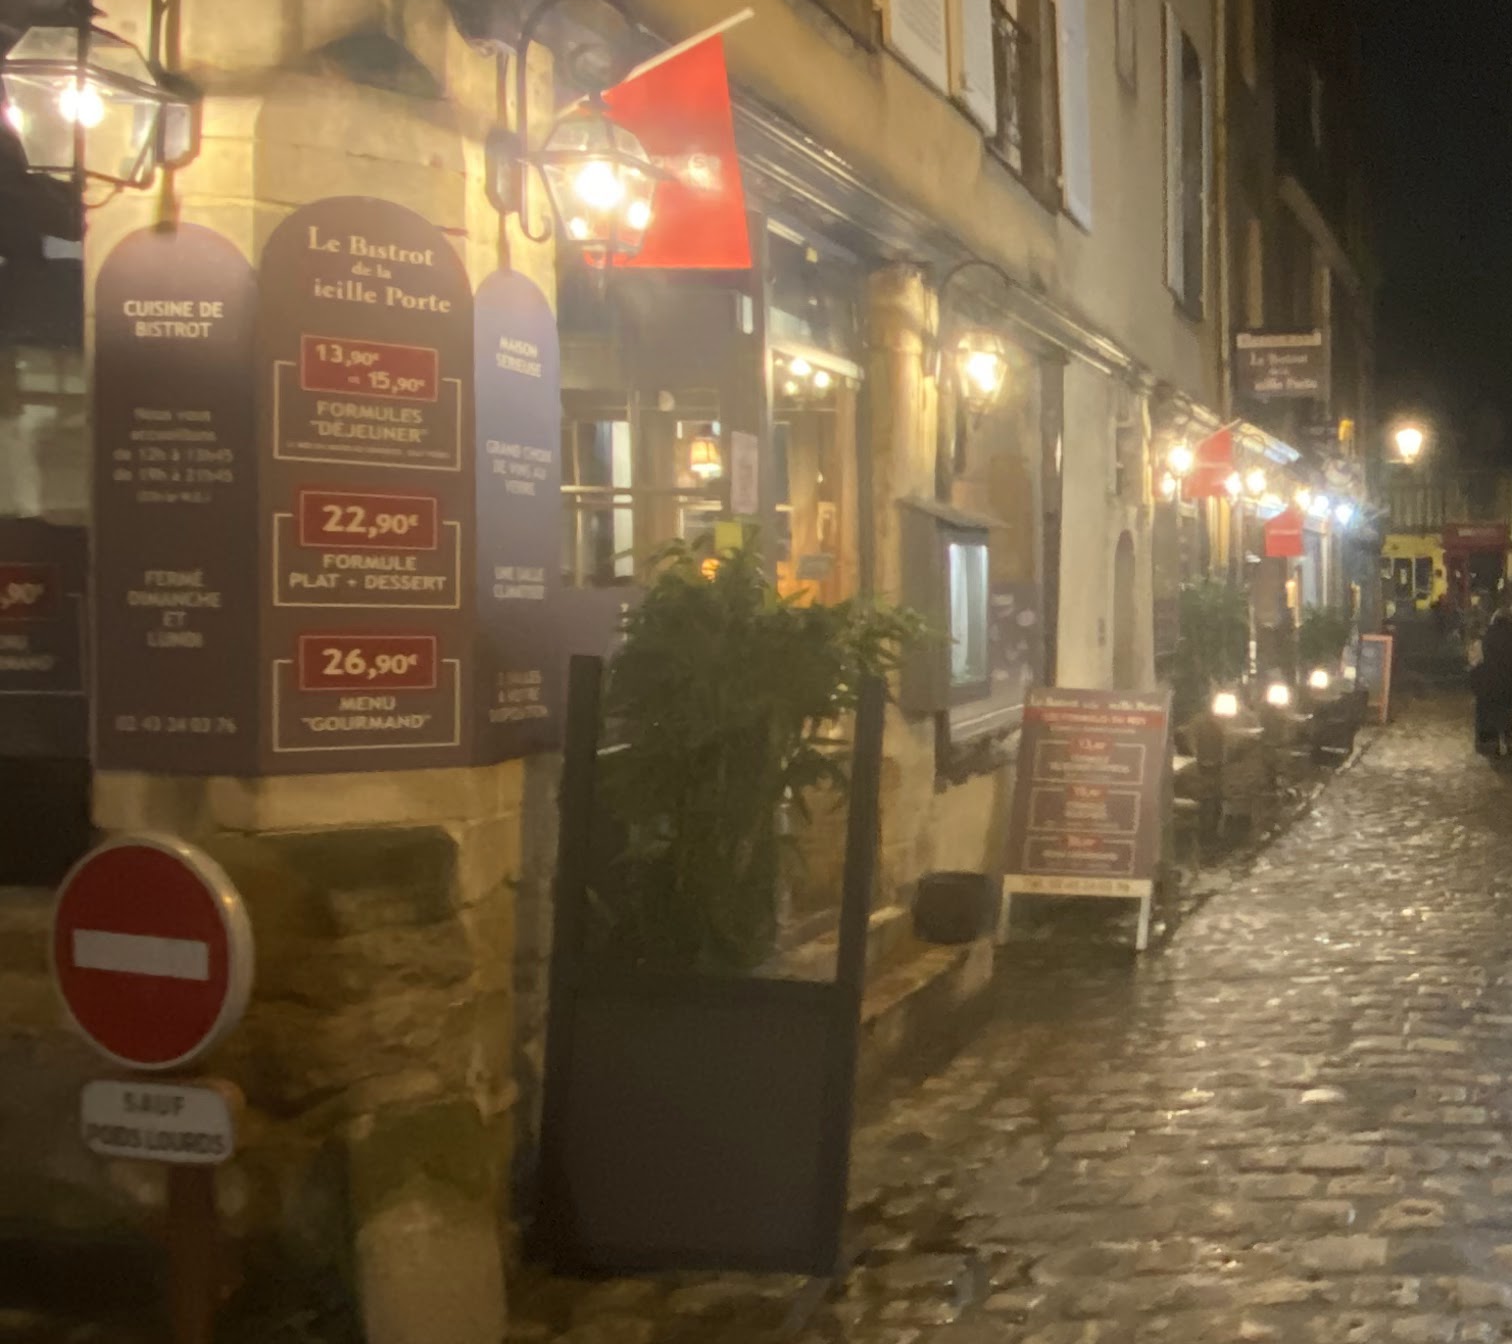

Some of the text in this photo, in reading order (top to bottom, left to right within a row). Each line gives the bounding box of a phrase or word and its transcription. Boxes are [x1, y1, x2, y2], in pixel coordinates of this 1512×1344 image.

[308, 225, 435, 267] Le Bistrot
[351, 260, 393, 280] de la
[122, 299, 224, 319] CUISINE DE
[385, 286, 452, 314] Porte
[134, 321, 213, 338] BISTROT
[316, 400, 423, 424] FORMULES
[321, 504, 420, 540] 22,90€
[322, 553, 417, 572] FORMULE
[288, 572, 340, 590] PLAT
[364, 576, 447, 591] DESSERT
[162, 610, 188, 628] ET
[321, 647, 419, 681] 26,90€
[338, 695, 397, 712] MENU
[300, 714, 433, 732] "GOURMAND"
